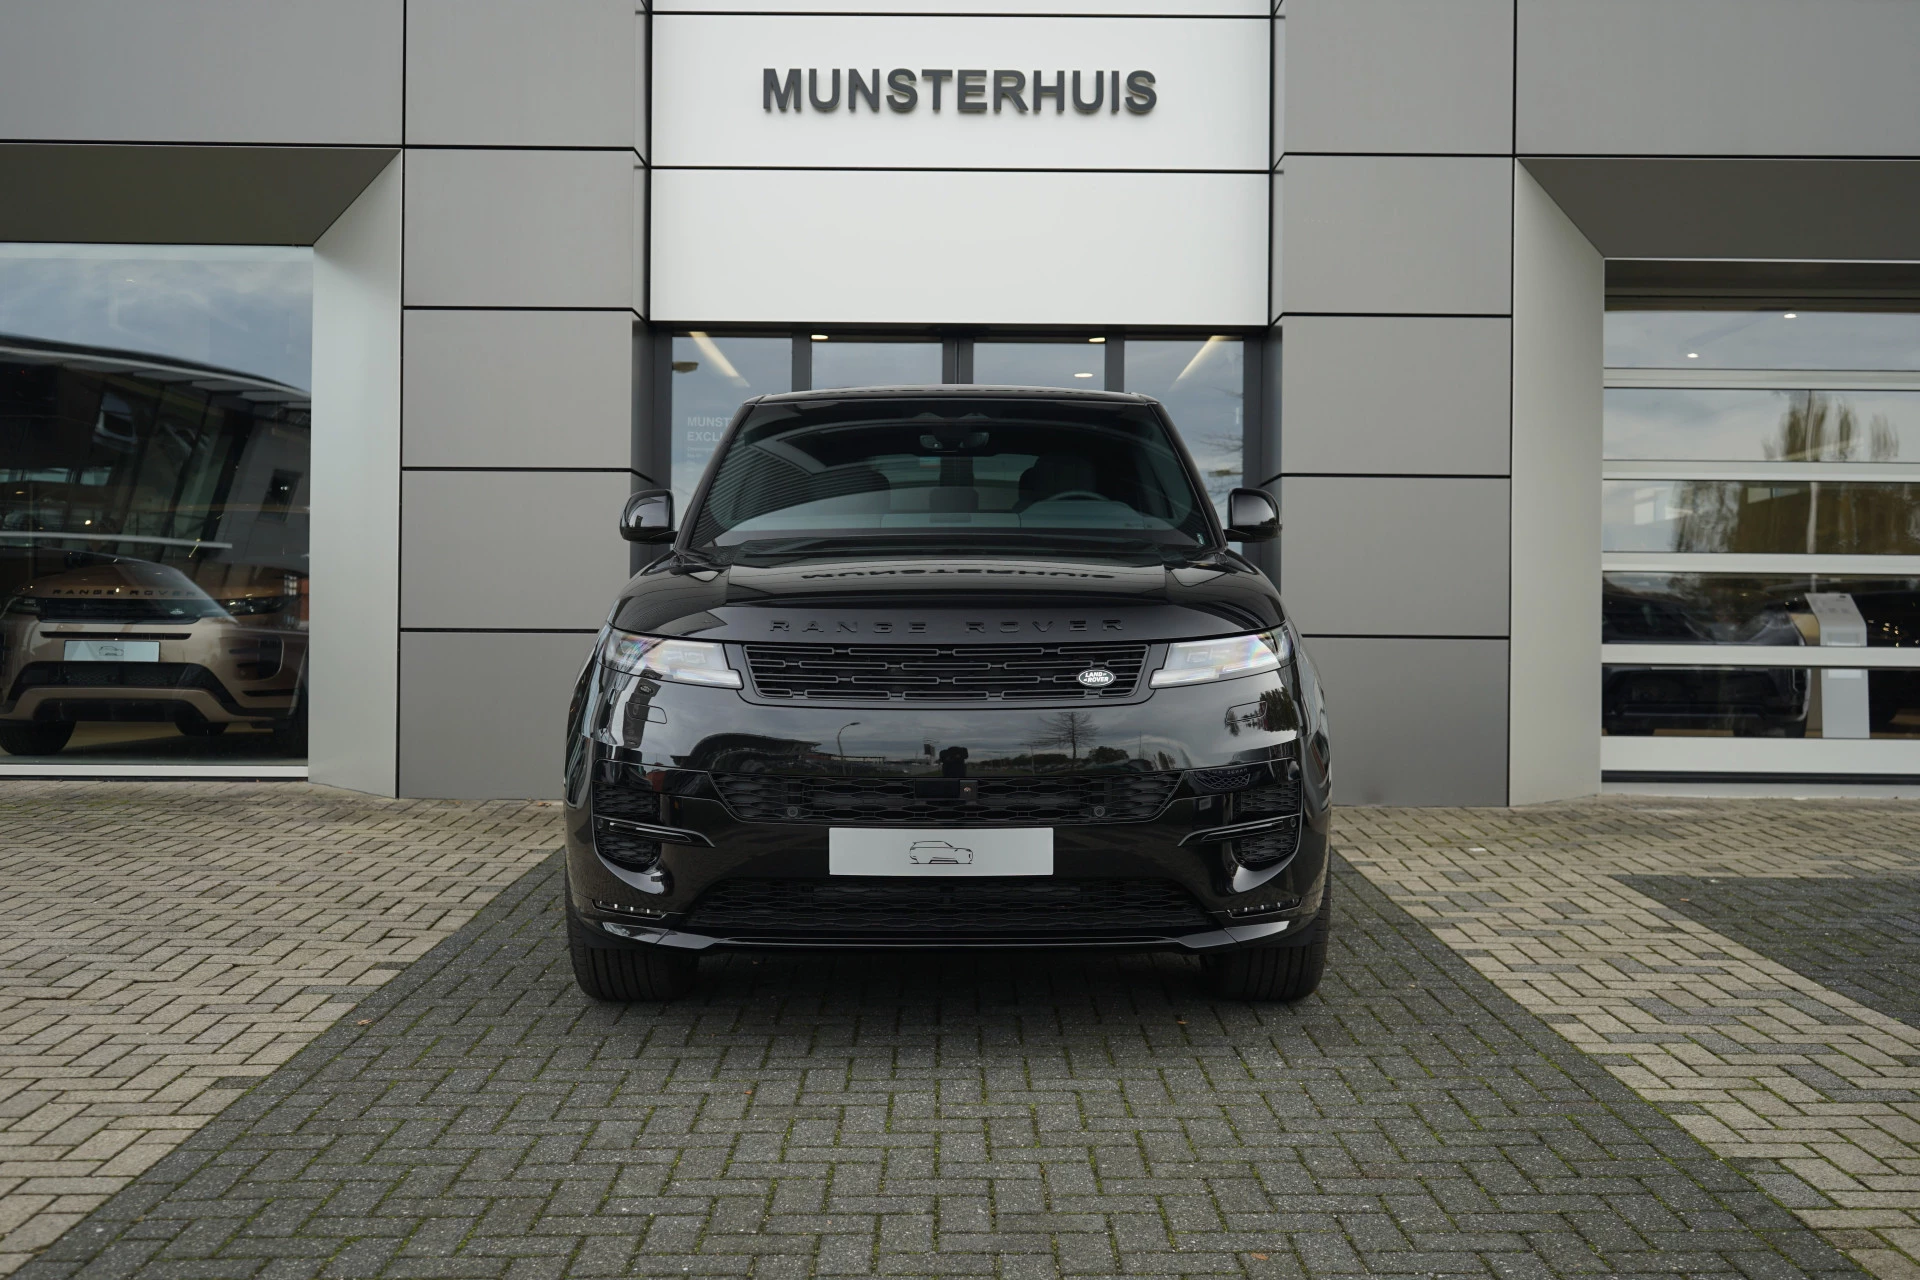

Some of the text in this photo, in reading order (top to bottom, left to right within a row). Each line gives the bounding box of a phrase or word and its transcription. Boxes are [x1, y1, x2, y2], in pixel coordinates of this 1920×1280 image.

[763, 68, 1158, 112] MUNSTERHUIS
[687, 416, 733, 427] MUNST
[769, 618, 1123, 634] RANGE ROVER
